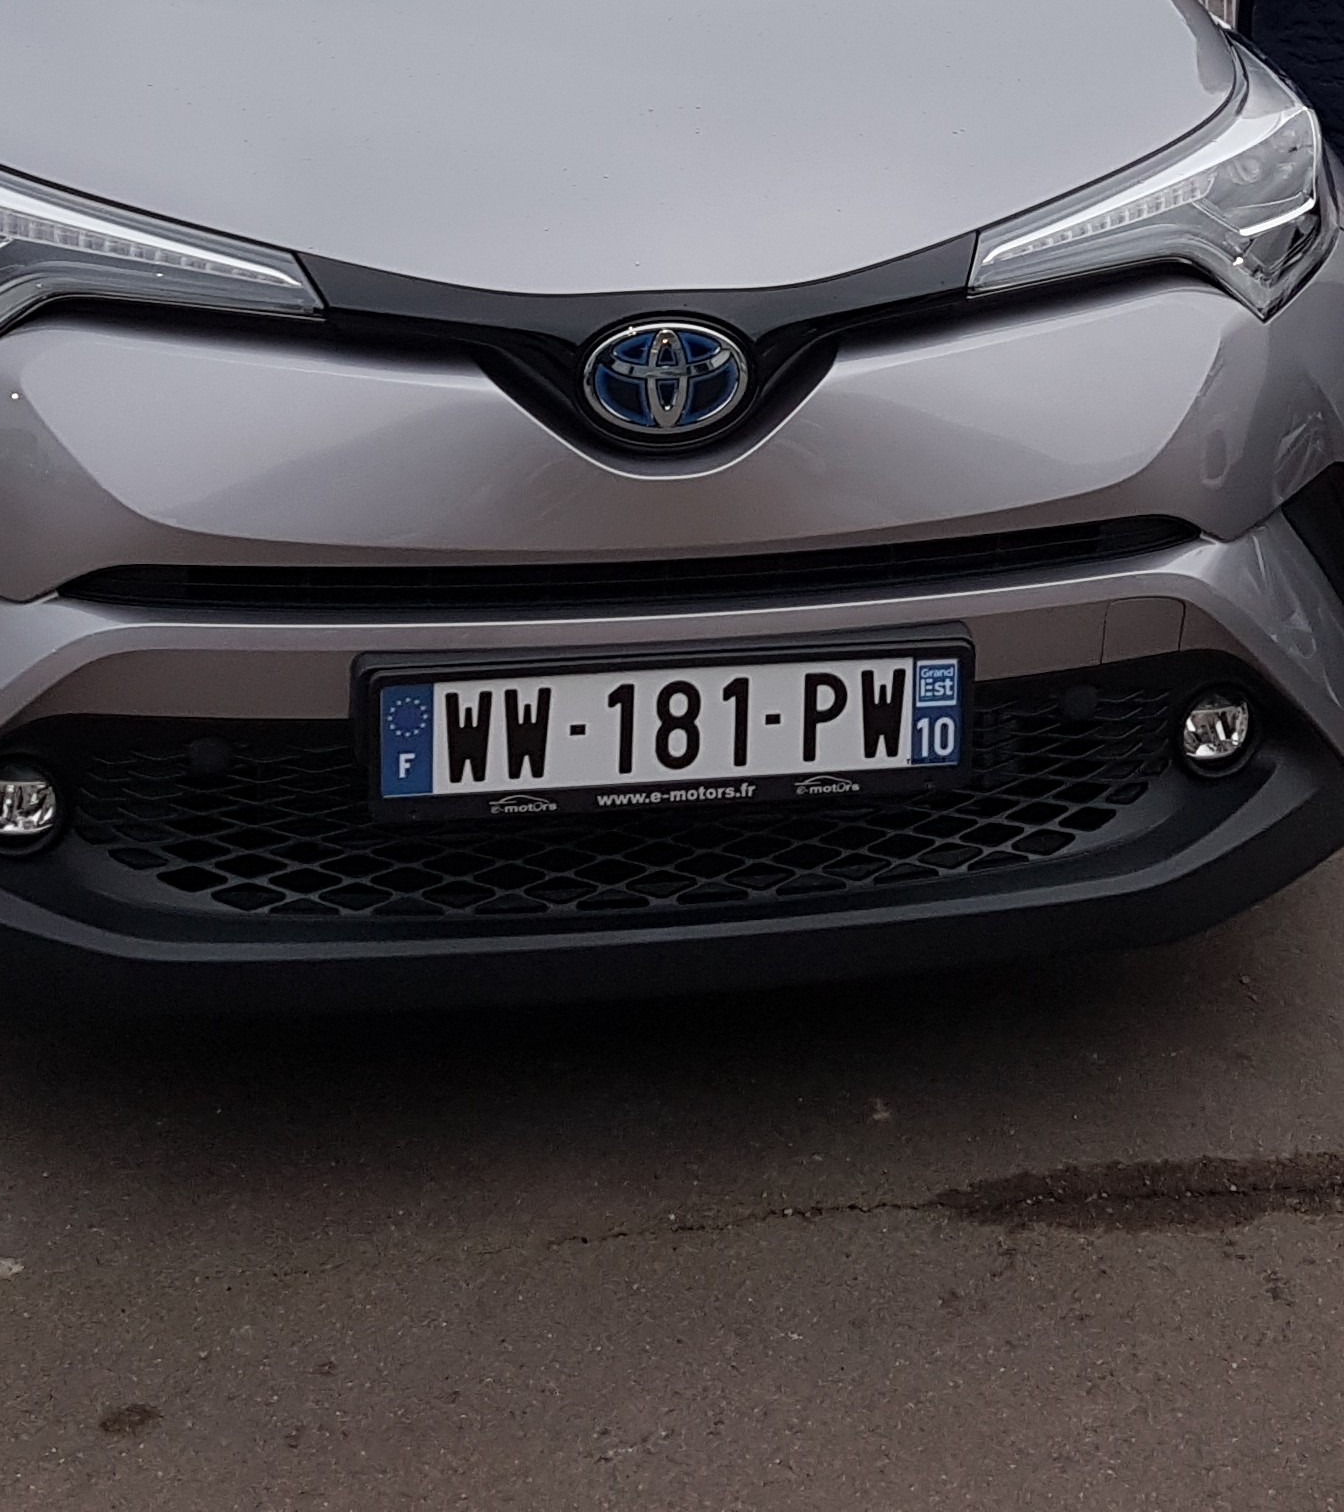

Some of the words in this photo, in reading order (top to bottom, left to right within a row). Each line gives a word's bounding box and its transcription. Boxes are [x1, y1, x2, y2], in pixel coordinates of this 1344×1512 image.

[920, 667, 954, 678] Grand
[920, 678, 954, 697] Est
[444, 668, 907, 784] WW-181-PW
[916, 716, 955, 758] 10
[398, 752, 416, 779] F
[597, 783, 755, 807] www.e-motors.fr
